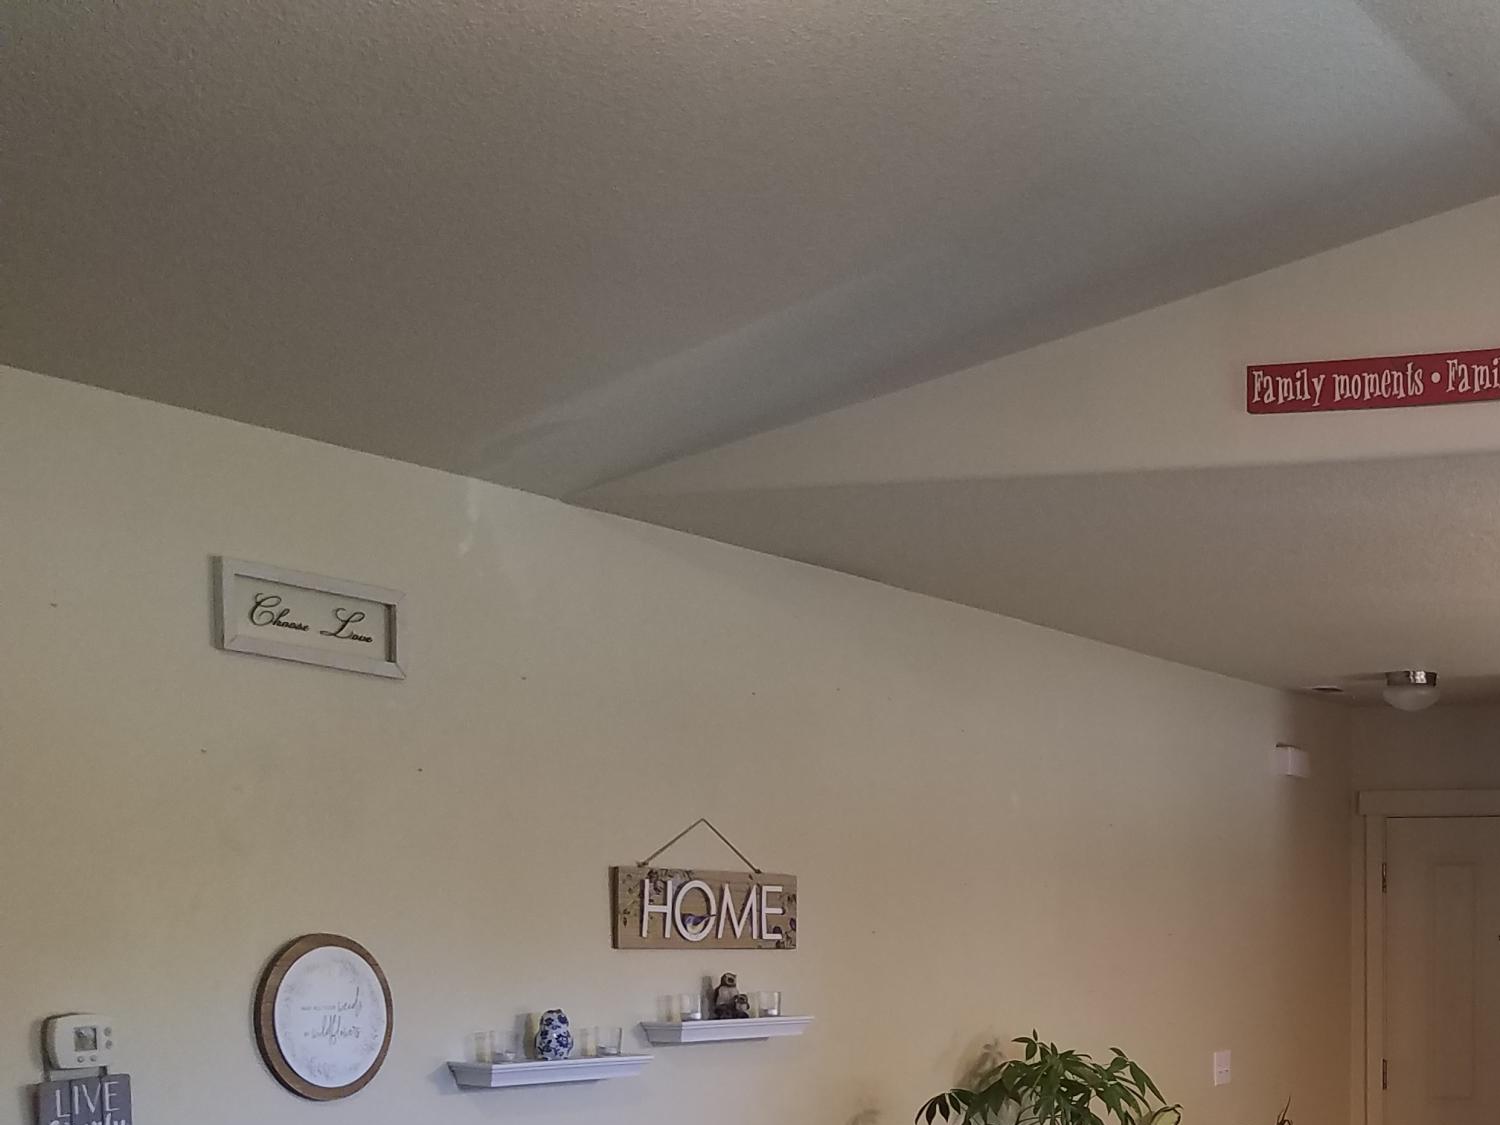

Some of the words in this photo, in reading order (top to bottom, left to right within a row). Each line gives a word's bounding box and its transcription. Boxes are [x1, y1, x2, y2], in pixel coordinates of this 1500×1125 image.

[1252, 369, 1326, 406] Family
[1332, 362, 1424, 401] moments
[250, 593, 310, 631] Choose
[319, 607, 374, 643] Love
[641, 878, 784, 942] HOME
[55, 1080, 120, 1118] LIVE
